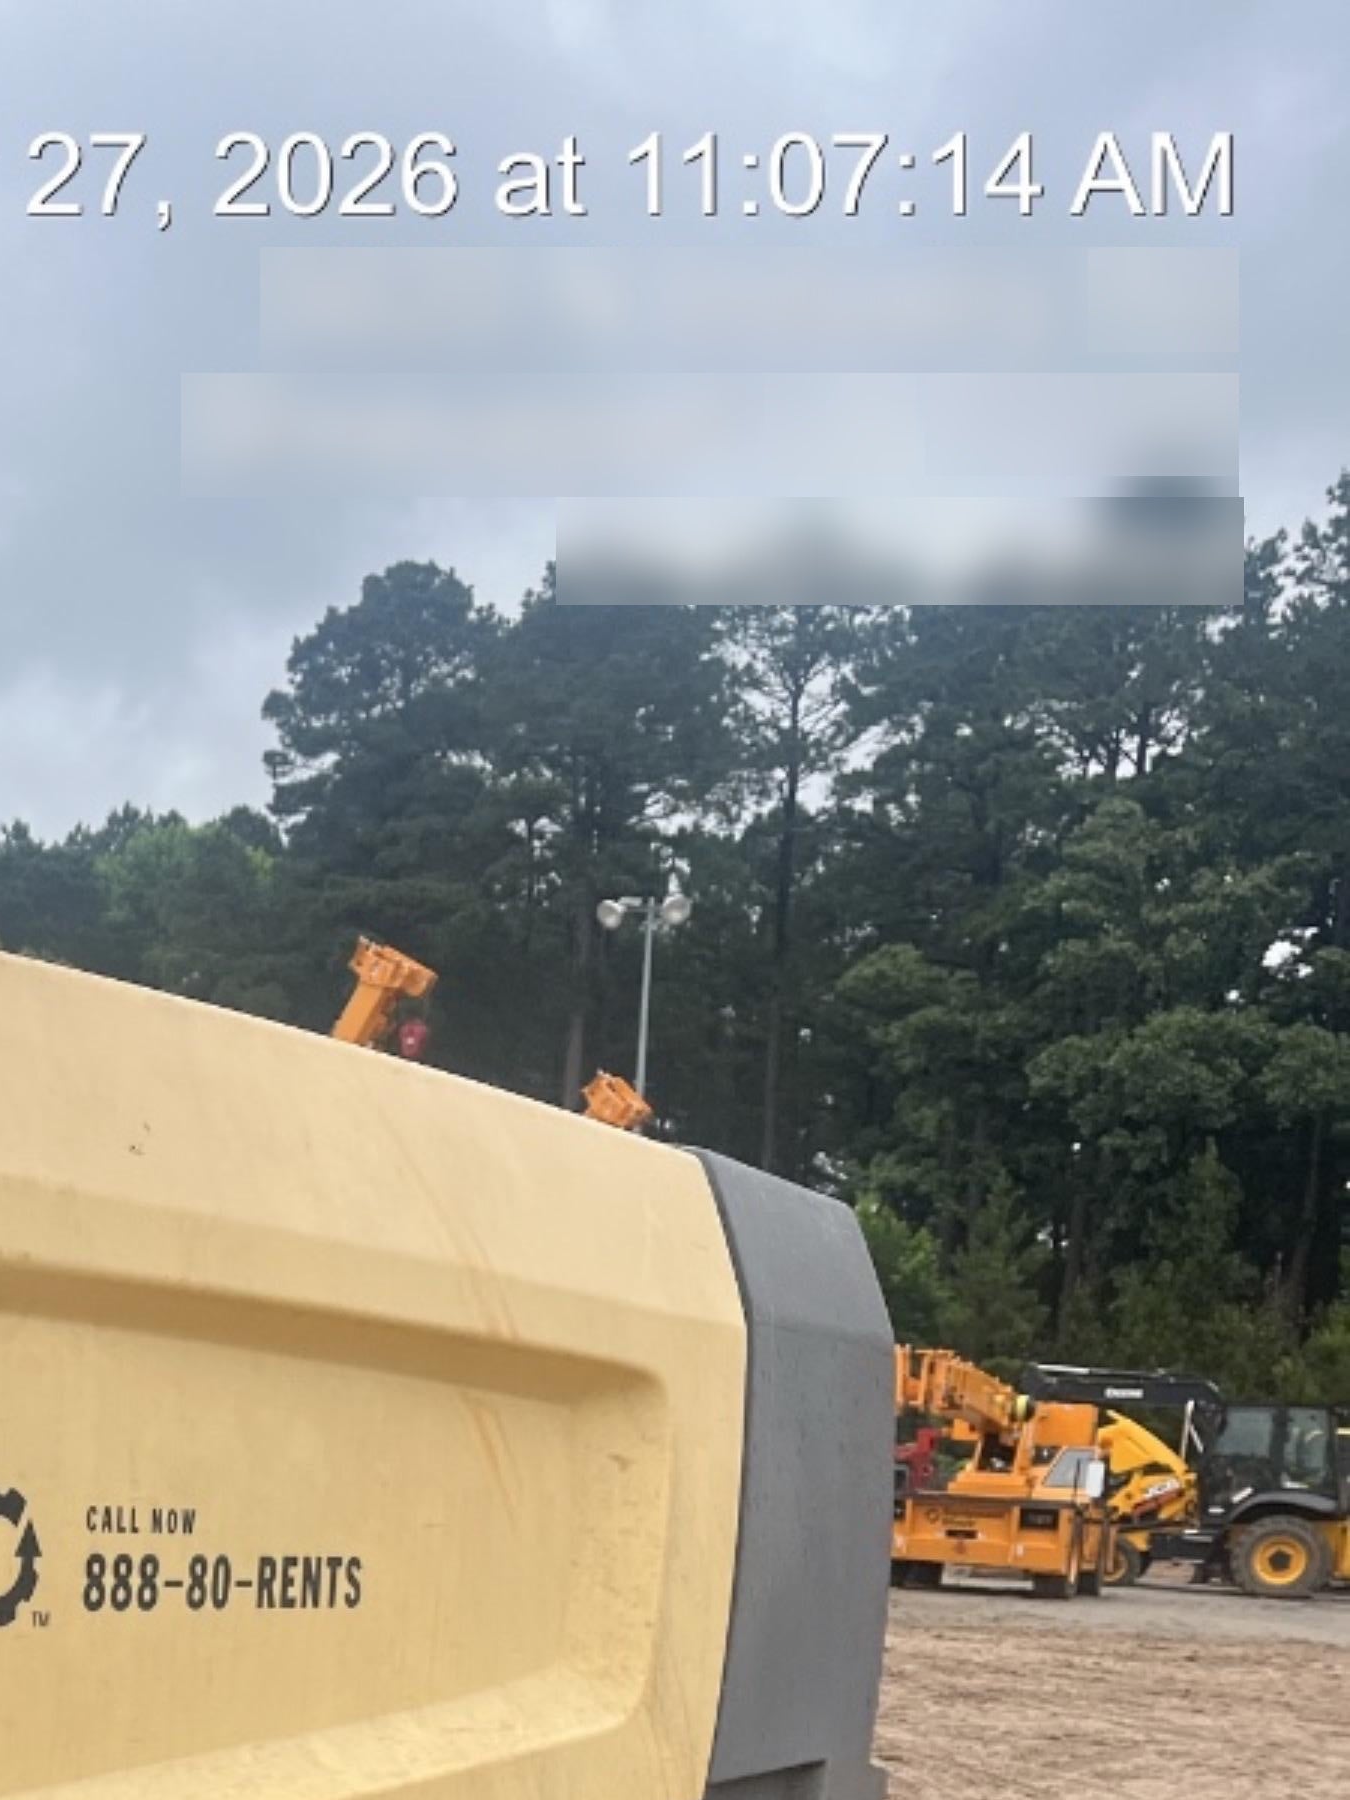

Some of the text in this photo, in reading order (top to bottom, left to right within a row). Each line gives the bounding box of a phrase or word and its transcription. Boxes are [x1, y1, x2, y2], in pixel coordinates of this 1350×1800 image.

[85, 1504, 197, 1535] CALL NOW
[82, 1552, 363, 1612] 888-80-RENTS
